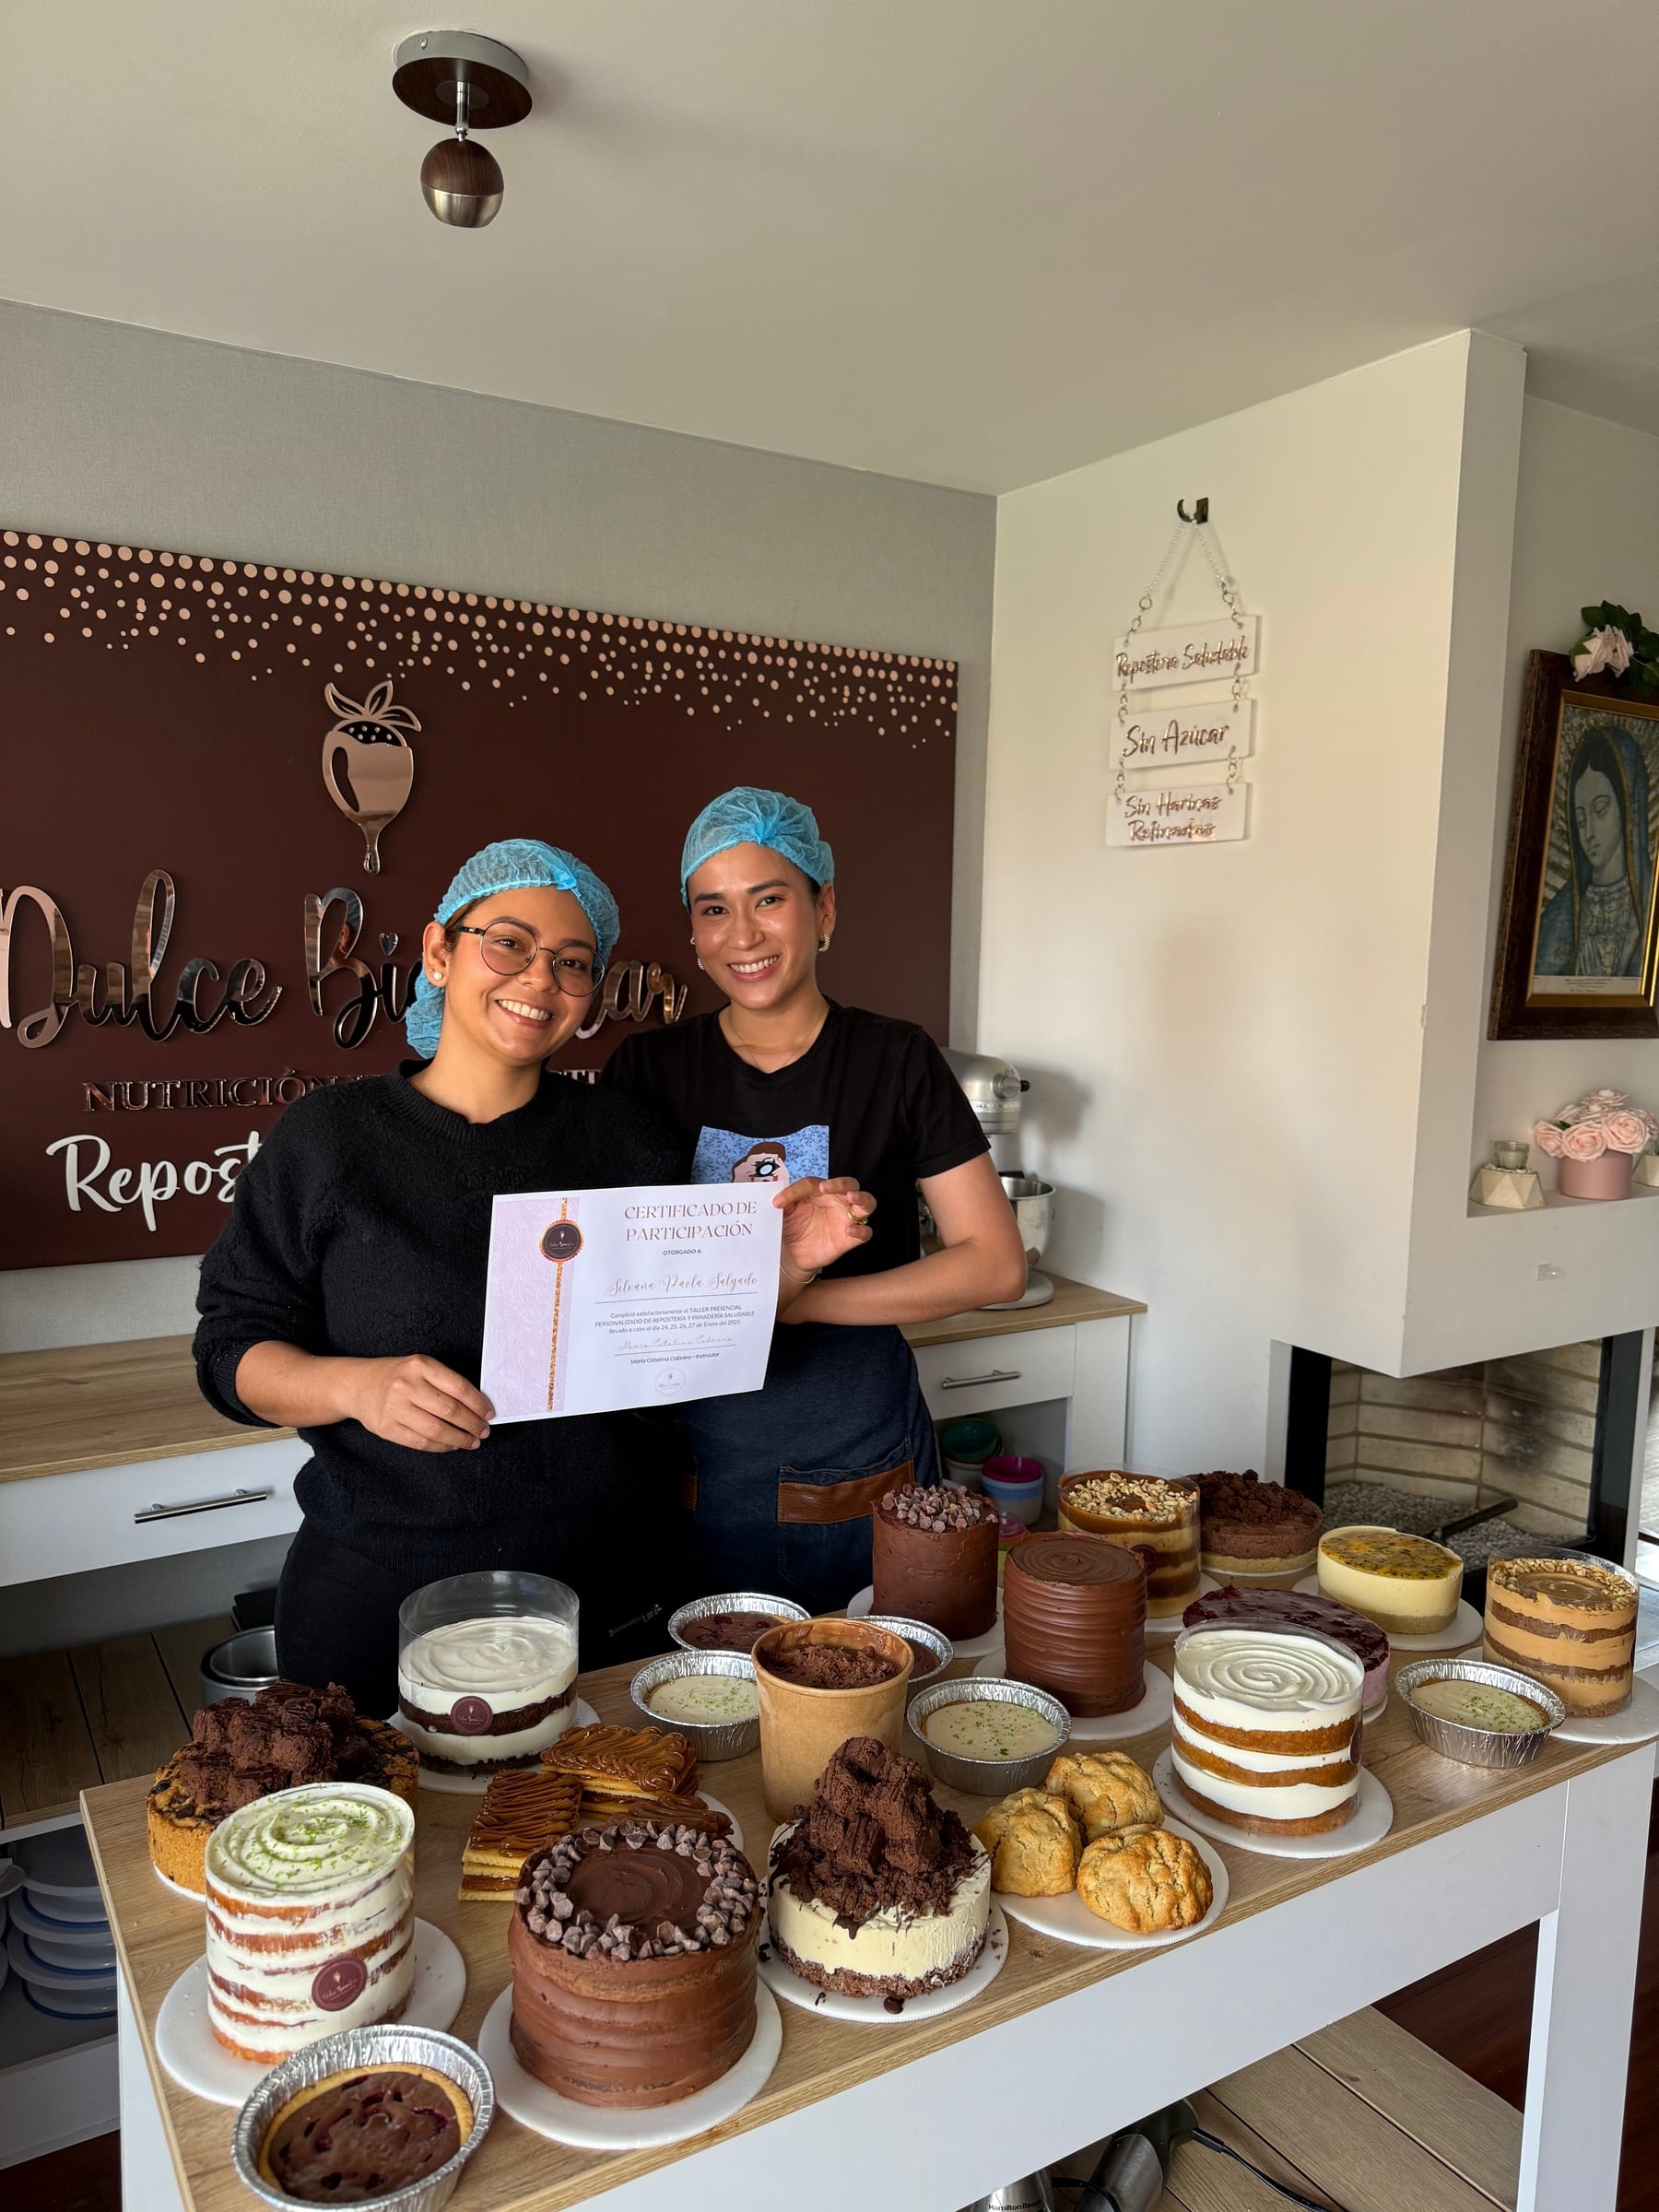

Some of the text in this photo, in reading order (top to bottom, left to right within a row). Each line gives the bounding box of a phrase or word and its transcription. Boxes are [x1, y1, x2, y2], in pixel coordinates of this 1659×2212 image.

[1182, 635, 1251, 671] Saludable
[1122, 724, 1156, 759] Sin
[1124, 791, 1222, 818] Sin Harinas
[0, 869, 283, 1050] Dulce
[45, 1130, 265, 1232] Repost
[624, 1201, 757, 1219] CERTIFICADO DE
[626, 1219, 753, 1241] PARTICIPACIÓN
[663, 1248, 696, 1256] OTORGADO
[659, 1274, 703, 1293] Paola
[708, 1272, 759, 1292] Salgado
[594, 1318, 642, 1327] PERSONALIZADO
[636, 1309, 683, 1317] satisfactoriamente
